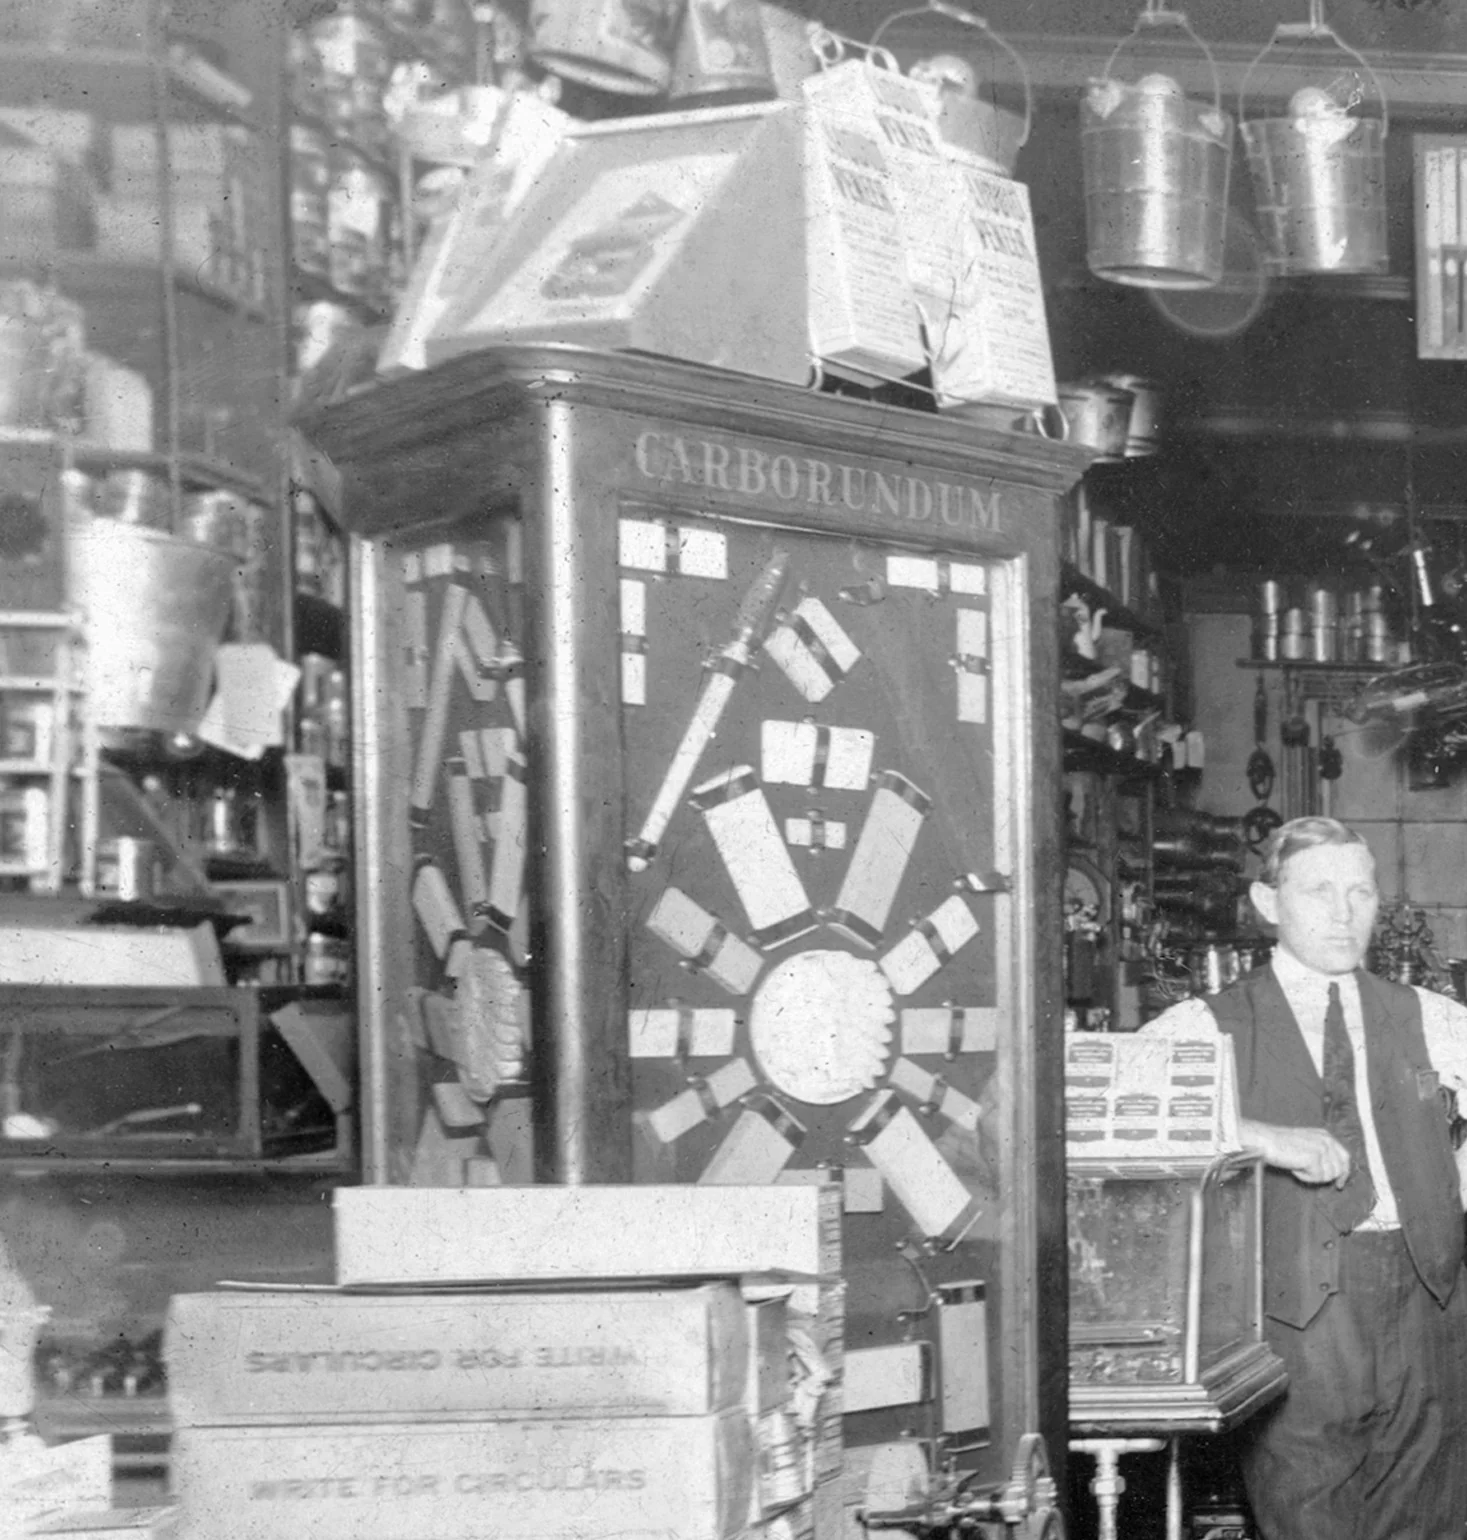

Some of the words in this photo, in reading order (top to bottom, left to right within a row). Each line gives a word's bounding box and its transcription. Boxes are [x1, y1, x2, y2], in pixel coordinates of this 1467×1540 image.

[635, 431, 1002, 533] CARBORUNDUM
[244, 1348, 442, 1374] CIRCULARS
[454, 1347, 523, 1371] FOR
[373, 1473, 440, 1497] FOR
[454, 1468, 648, 1495] CIRCULARS
